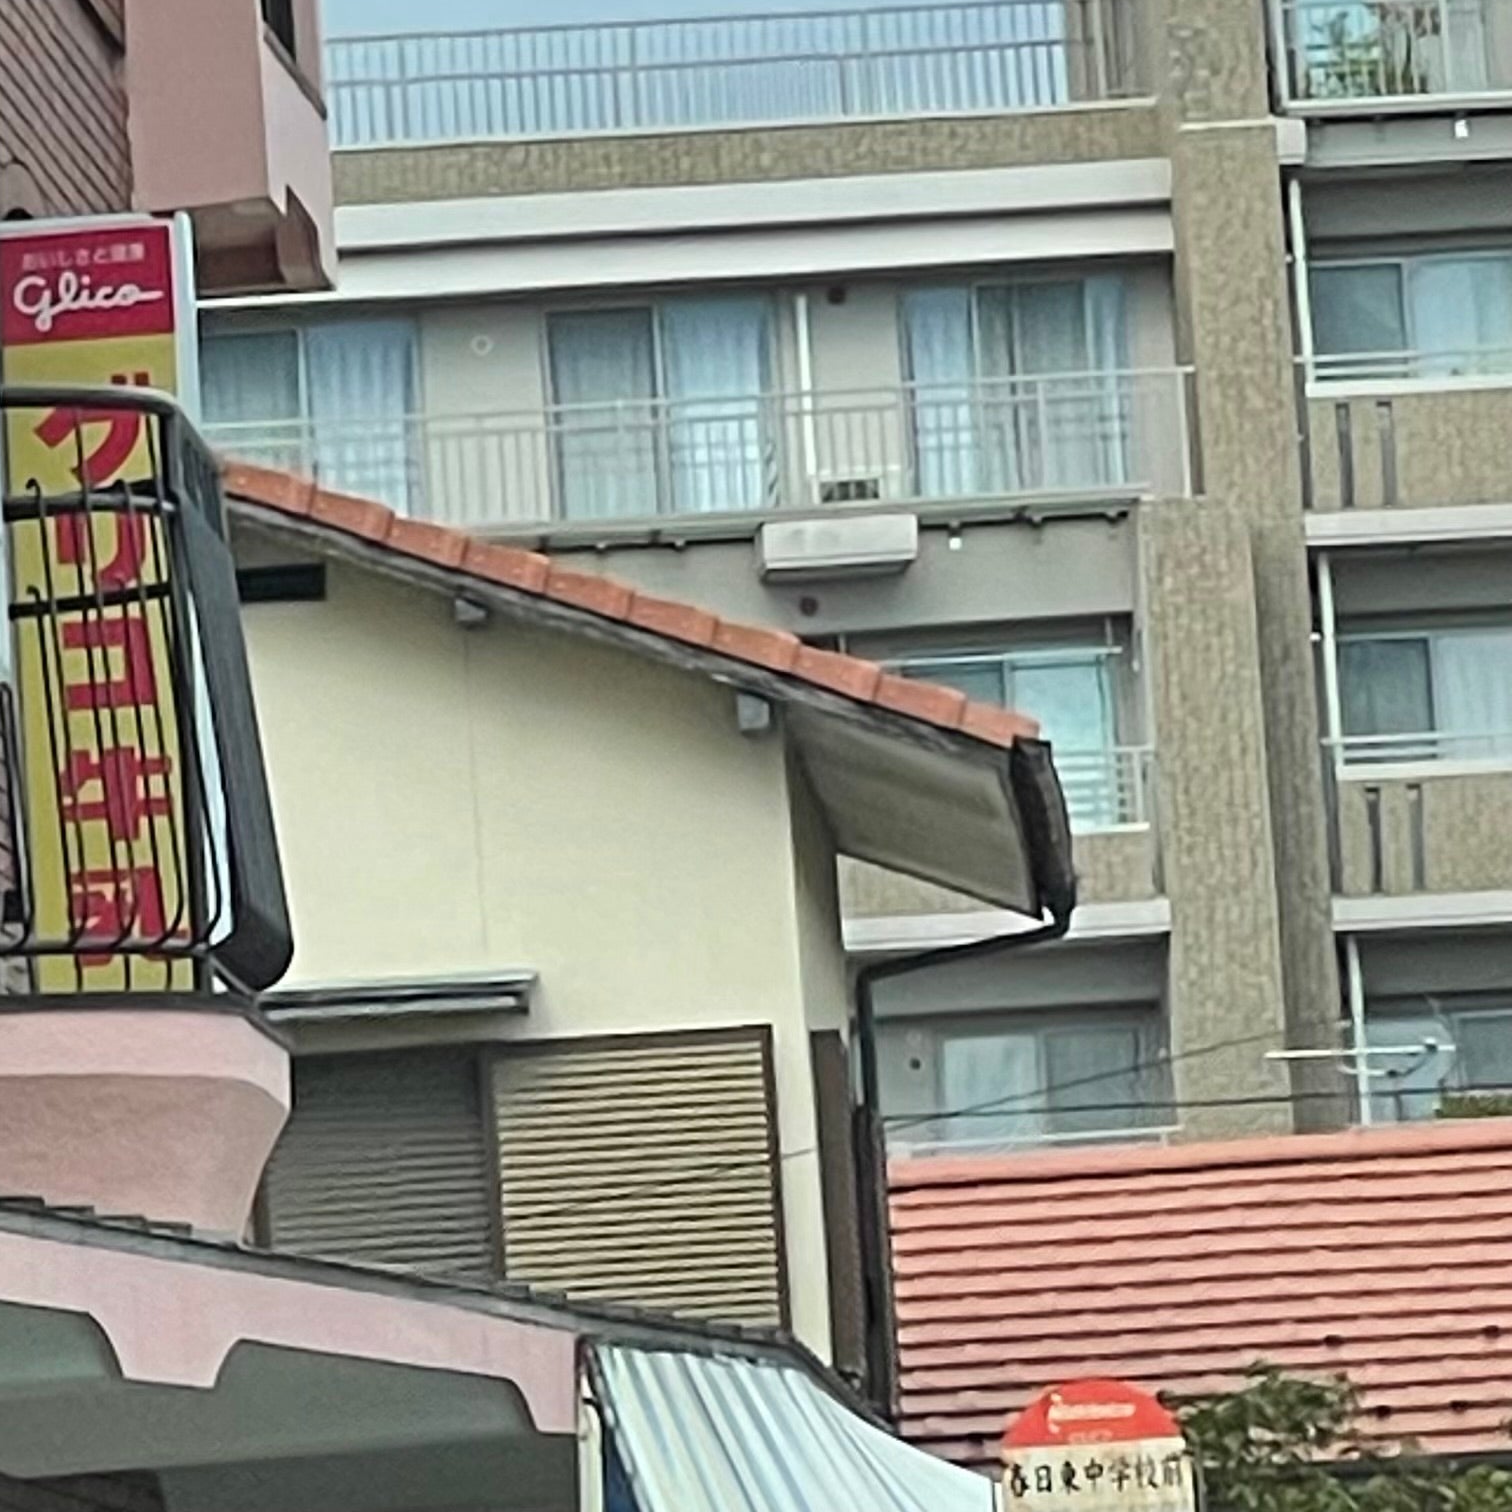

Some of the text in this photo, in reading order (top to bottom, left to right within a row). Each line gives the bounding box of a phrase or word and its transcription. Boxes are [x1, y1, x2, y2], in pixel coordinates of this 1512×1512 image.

[33, 371, 190, 966] グリコ牛乳
